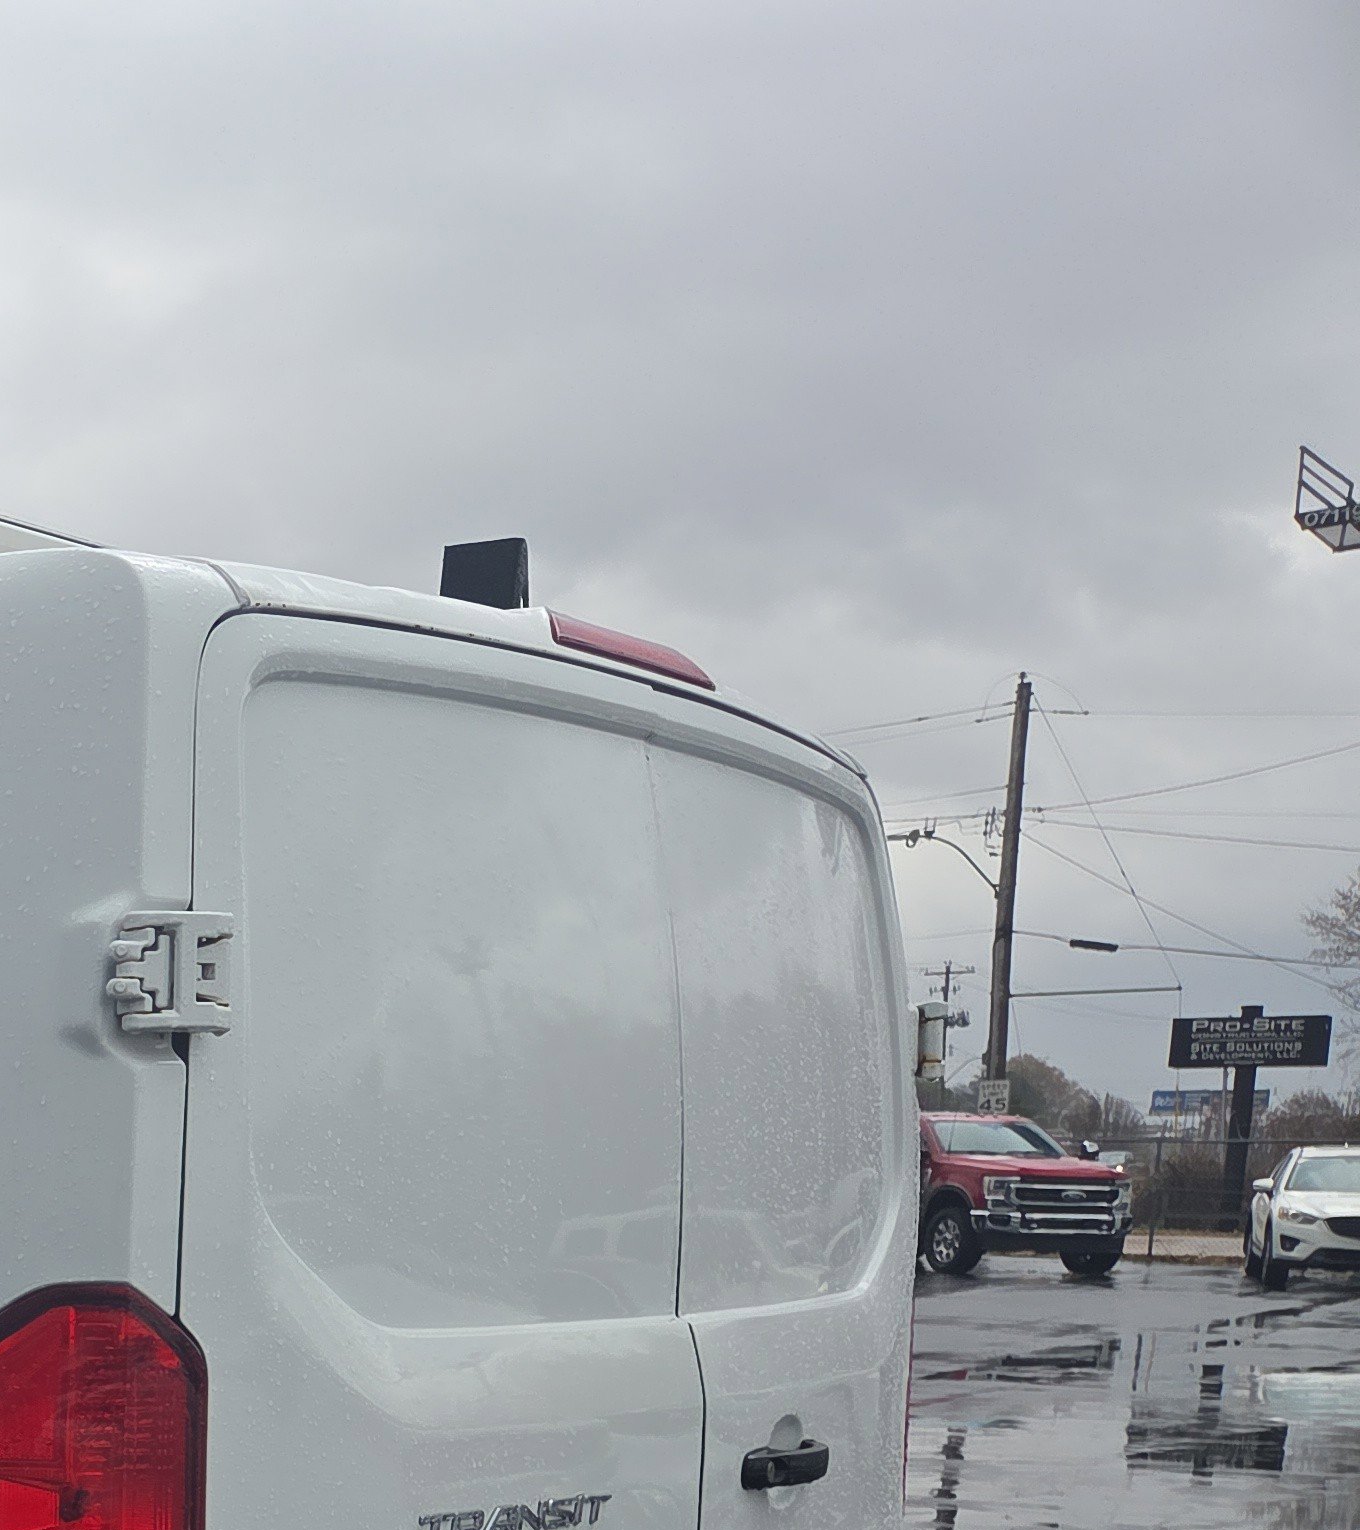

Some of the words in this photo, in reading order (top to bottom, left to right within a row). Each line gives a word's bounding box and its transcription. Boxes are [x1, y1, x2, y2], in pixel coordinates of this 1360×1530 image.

[1192, 1018, 1305, 1032] PRO-SITE
[1191, 1042, 1220, 1053] SITE
[1226, 1041, 1302, 1052] SOLUTIONS
[979, 1098, 1007, 1111] 45
